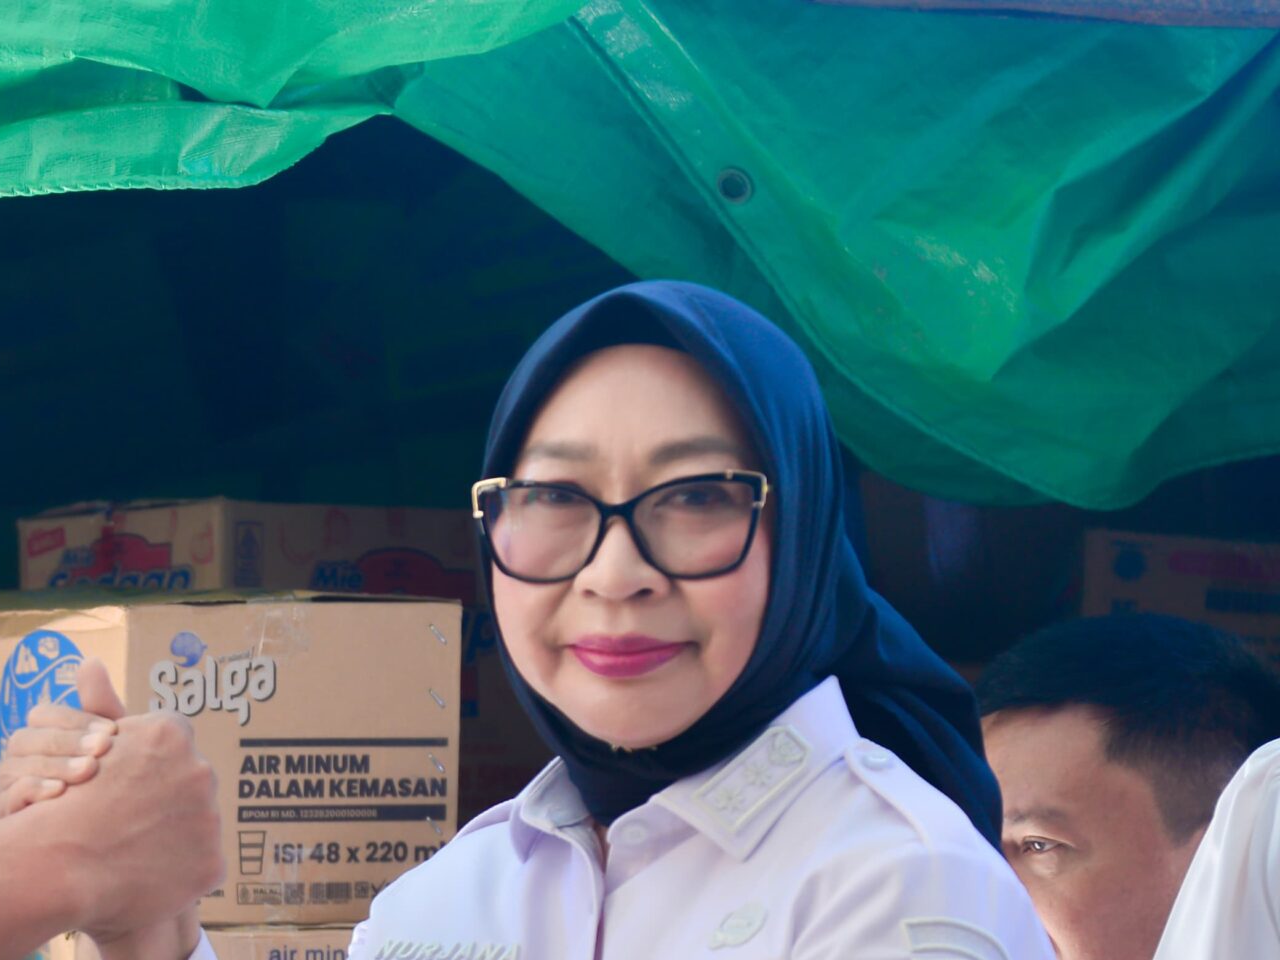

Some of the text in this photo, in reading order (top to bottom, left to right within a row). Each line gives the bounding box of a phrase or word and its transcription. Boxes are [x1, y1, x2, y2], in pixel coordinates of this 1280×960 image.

[150, 656, 277, 727] Salga
[240, 754, 370, 775] AIR MINUM
[238, 778, 447, 799] DALAM KEMASAN
[309, 842, 341, 864] 48
[346, 847, 362, 863] x
[366, 840, 409, 863] 220
